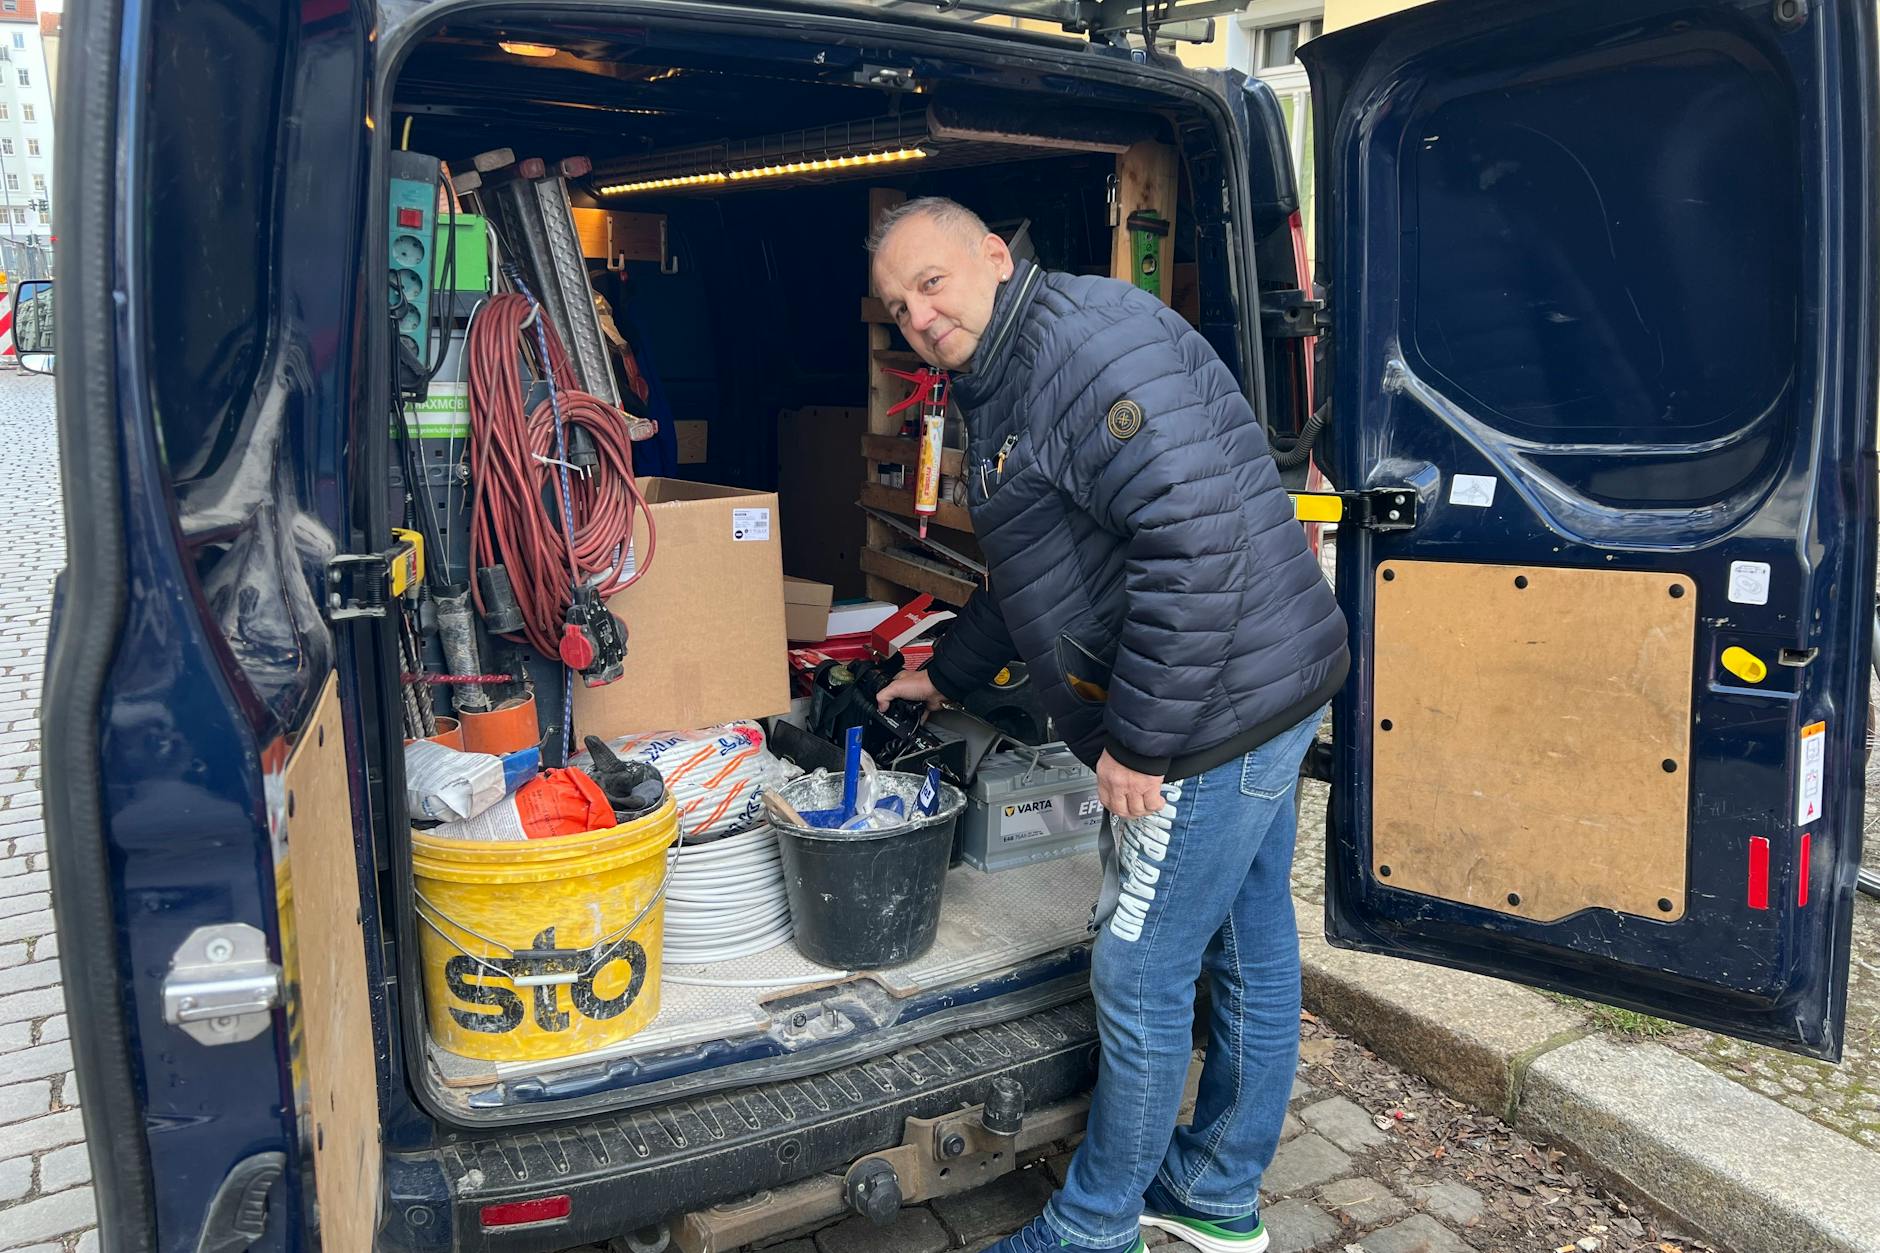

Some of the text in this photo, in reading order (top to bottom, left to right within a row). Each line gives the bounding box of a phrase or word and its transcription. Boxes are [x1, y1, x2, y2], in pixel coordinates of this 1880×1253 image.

[1018, 800, 1052, 813] VARTA
[1110, 857, 1161, 942] DAVID
[445, 926, 647, 1033] sto
